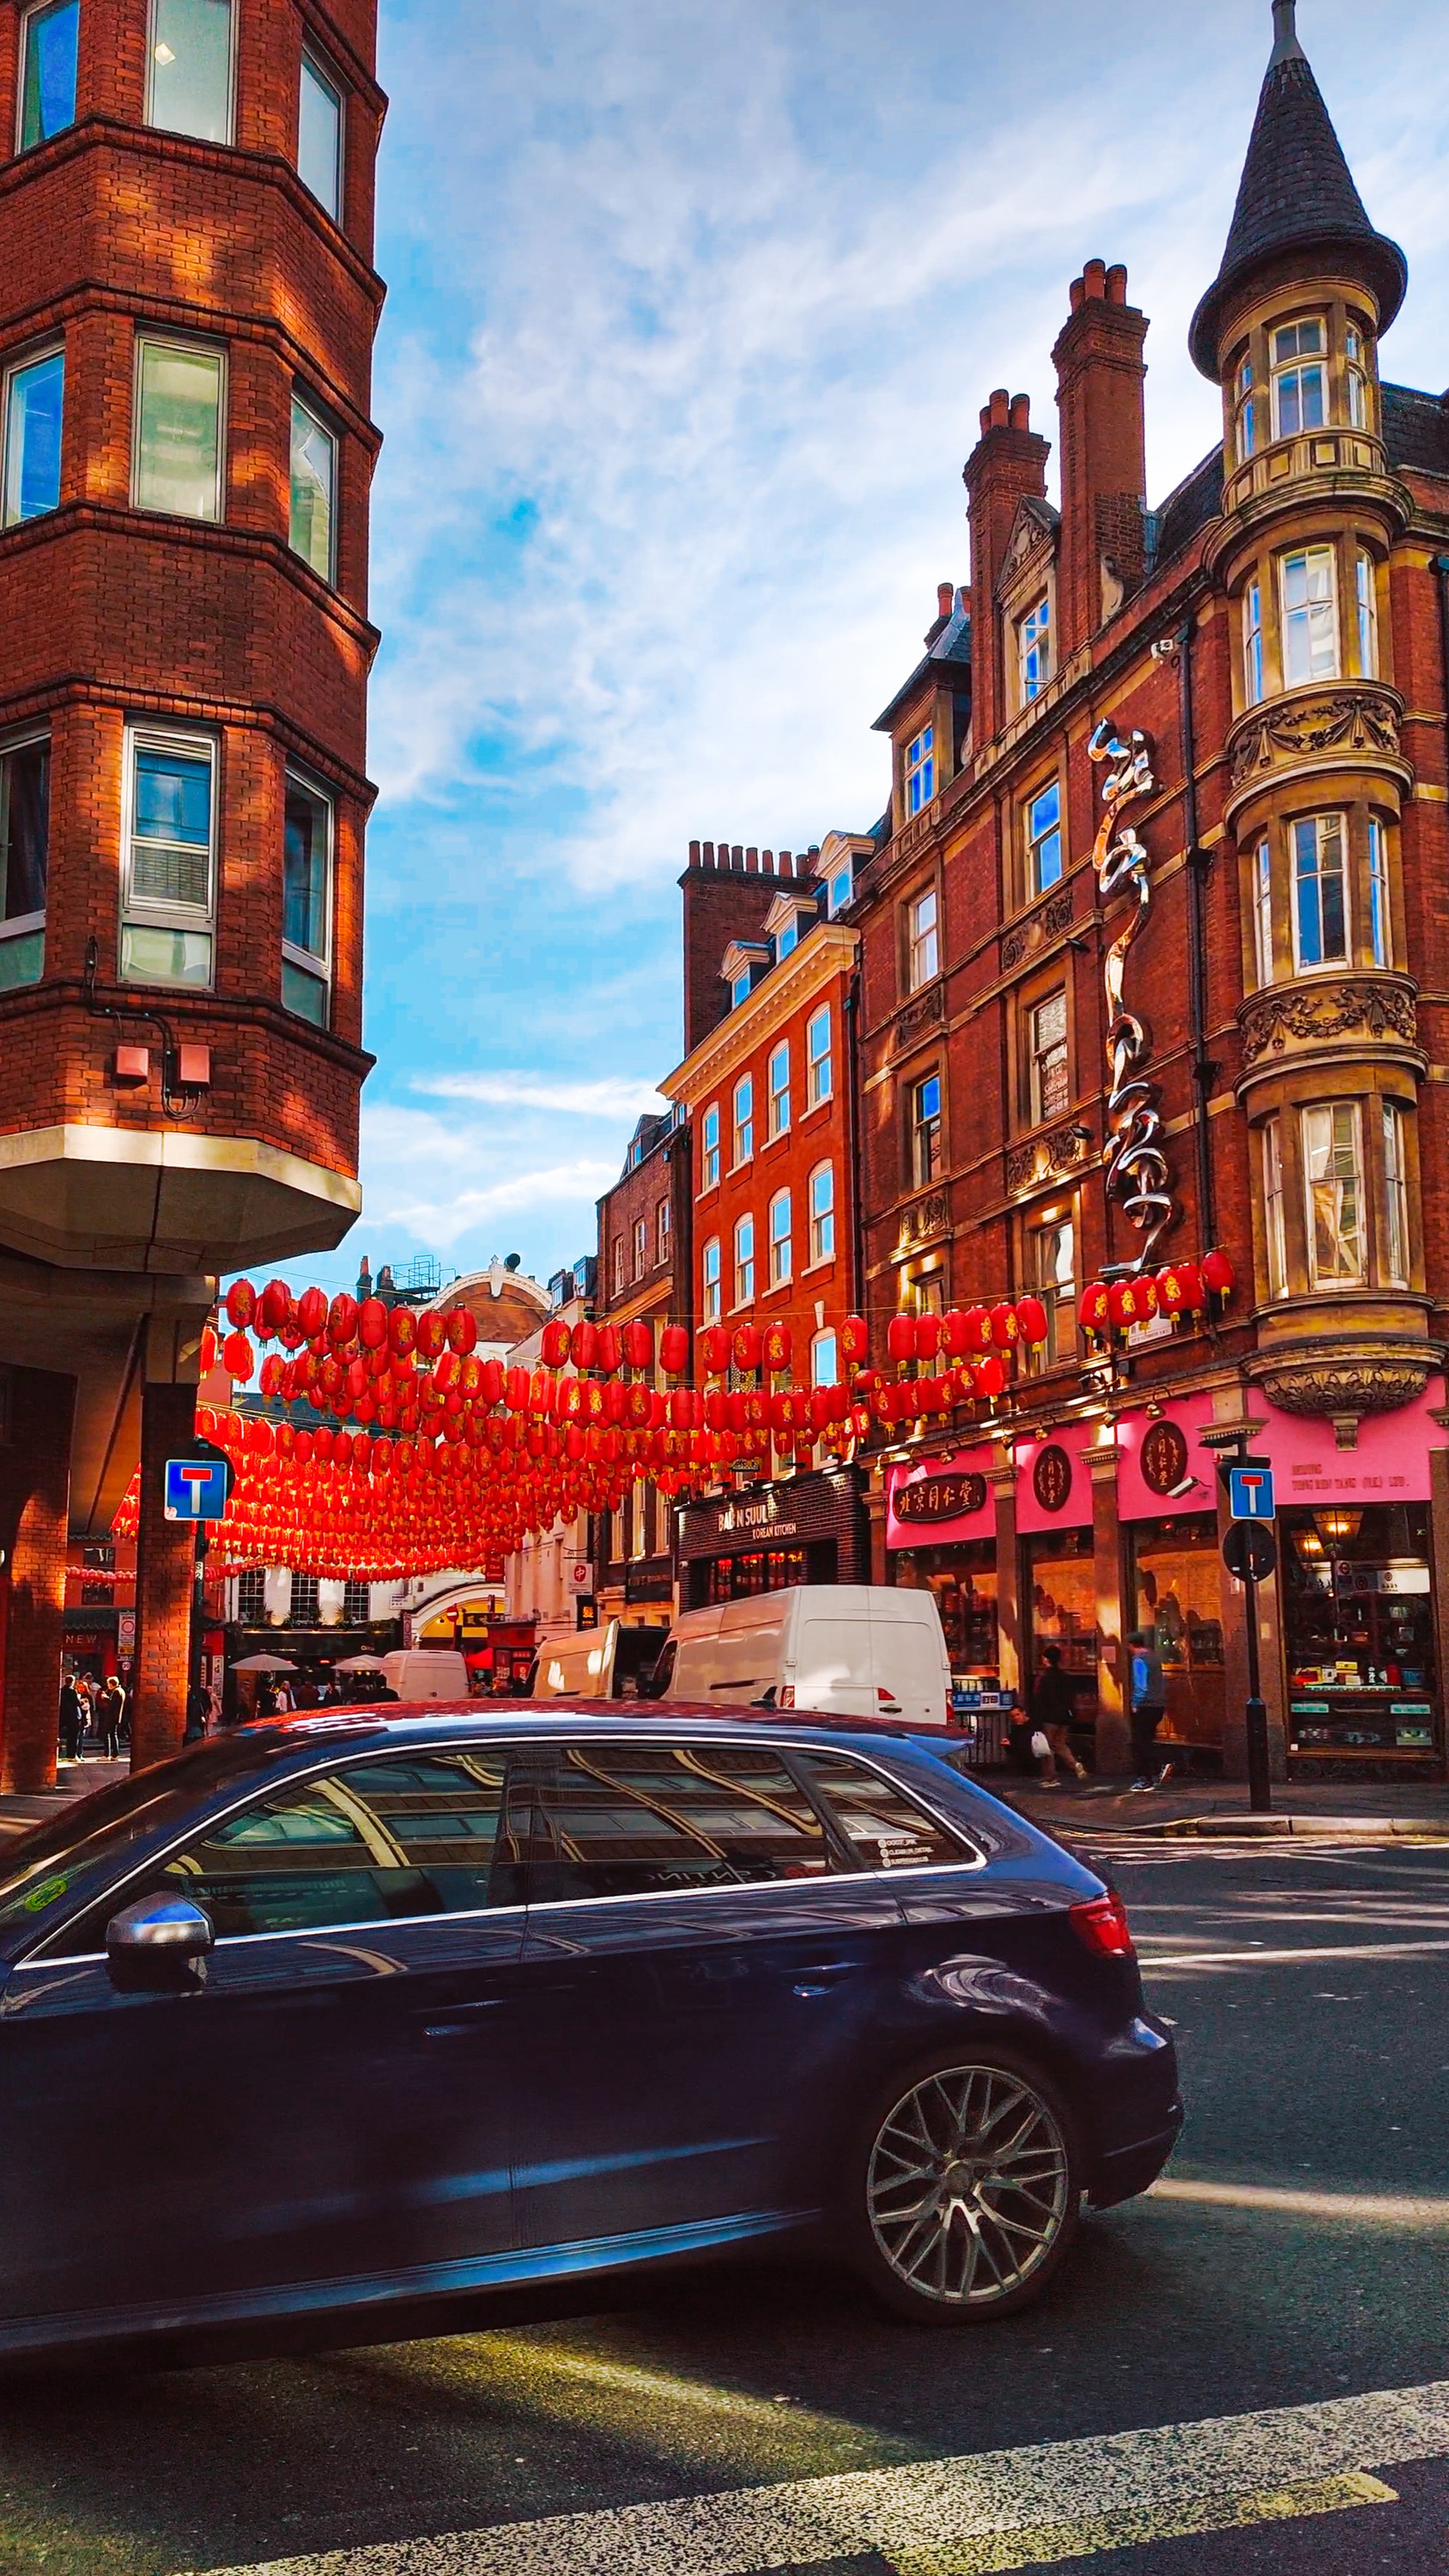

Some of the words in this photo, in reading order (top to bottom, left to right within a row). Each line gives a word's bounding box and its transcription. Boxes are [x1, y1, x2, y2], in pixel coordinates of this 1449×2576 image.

[718, 1509, 736, 1532] BAB
[736, 1508, 745, 1528] N
[745, 1504, 770, 1527] SUUL
[752, 1526, 773, 1540] KOREAN
[773, 1522, 797, 1537] KITCHEN
[65, 1634, 97, 1644] NEW
